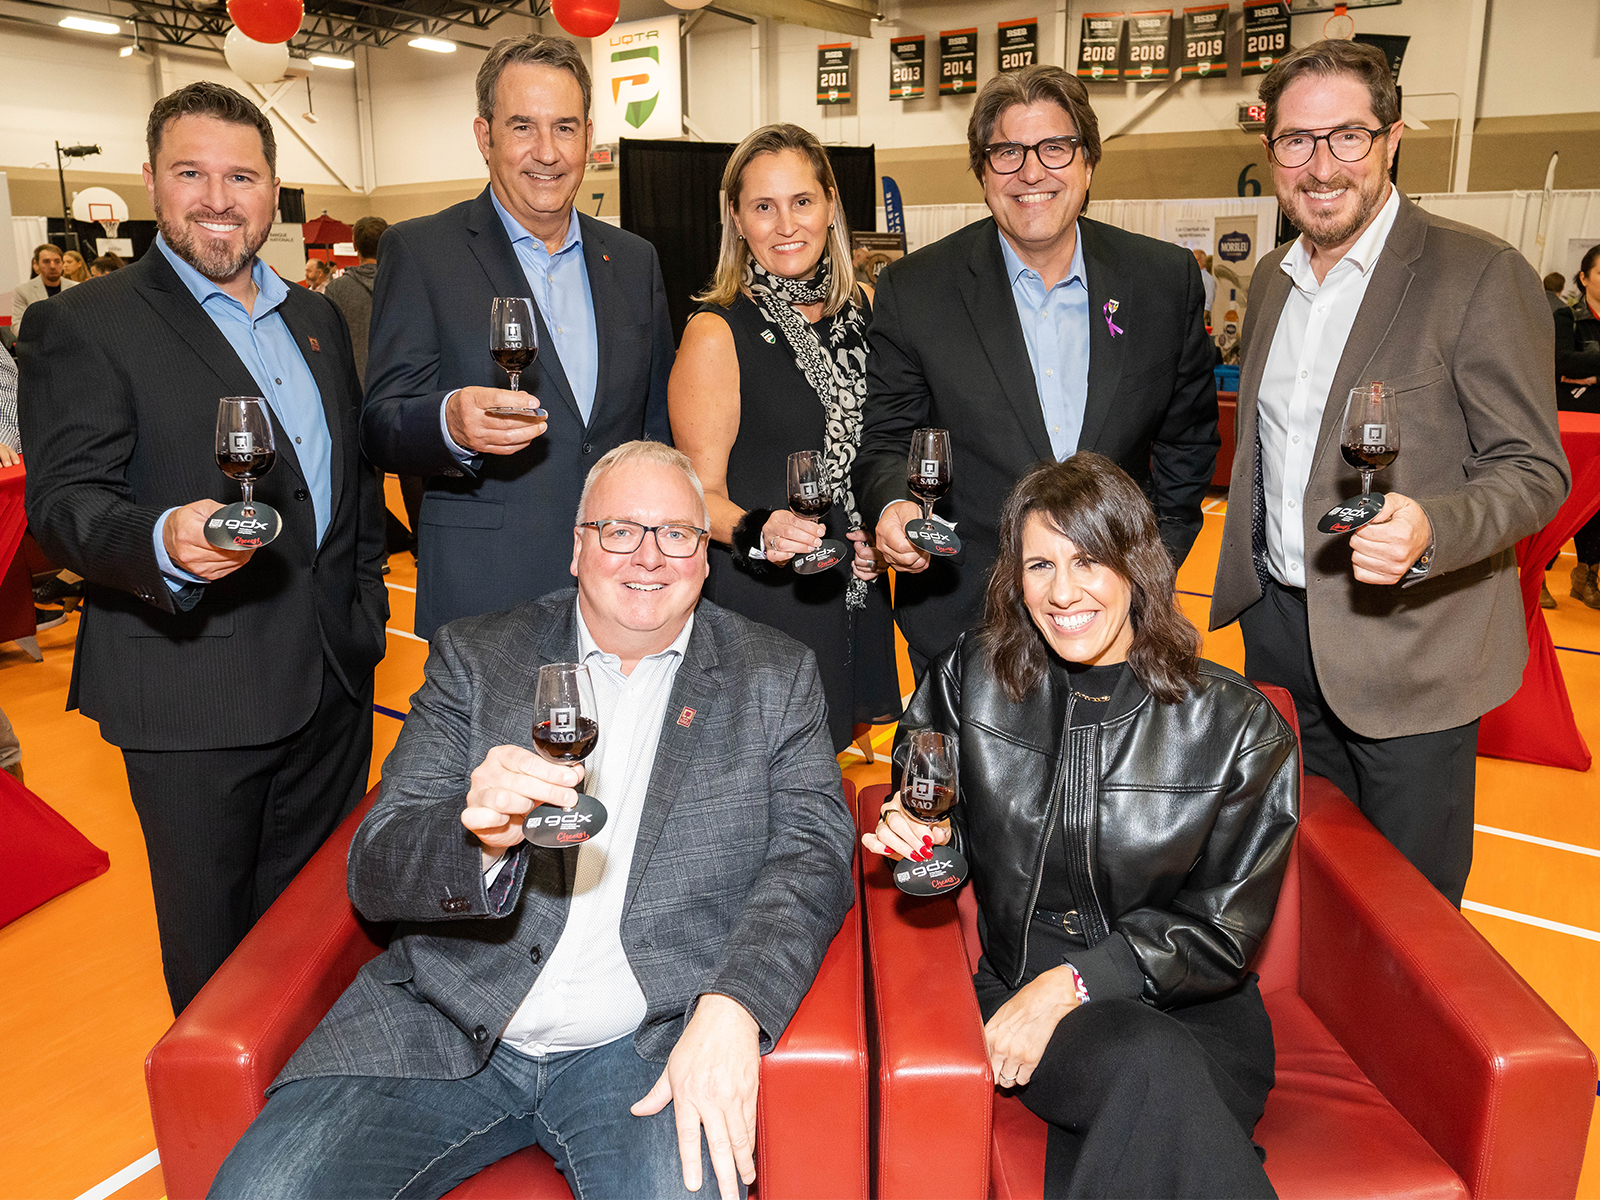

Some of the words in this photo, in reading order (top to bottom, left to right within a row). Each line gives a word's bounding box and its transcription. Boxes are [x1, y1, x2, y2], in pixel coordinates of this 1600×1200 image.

[610, 30, 659, 46] UQTR
[1247, 33, 1285, 53] 2019
[1082, 46, 1116, 61] 2018
[1130, 44, 1165, 60] 2018
[1186, 39, 1223, 58] 2019
[943, 60, 973, 76] 2014
[1002, 51, 1033, 69] 2017
[820, 72, 847, 87] 2011
[893, 67, 920, 82] 2013
[1238, 163, 1262, 197] 6
[592, 193, 604, 216] 7
[1220, 242, 1249, 252] MORBLEU
[225, 519, 269, 530] gdx
[544, 812, 593, 827] gdx
[912, 860, 953, 878] gdx
[931, 875, 960, 889] Cheers!
